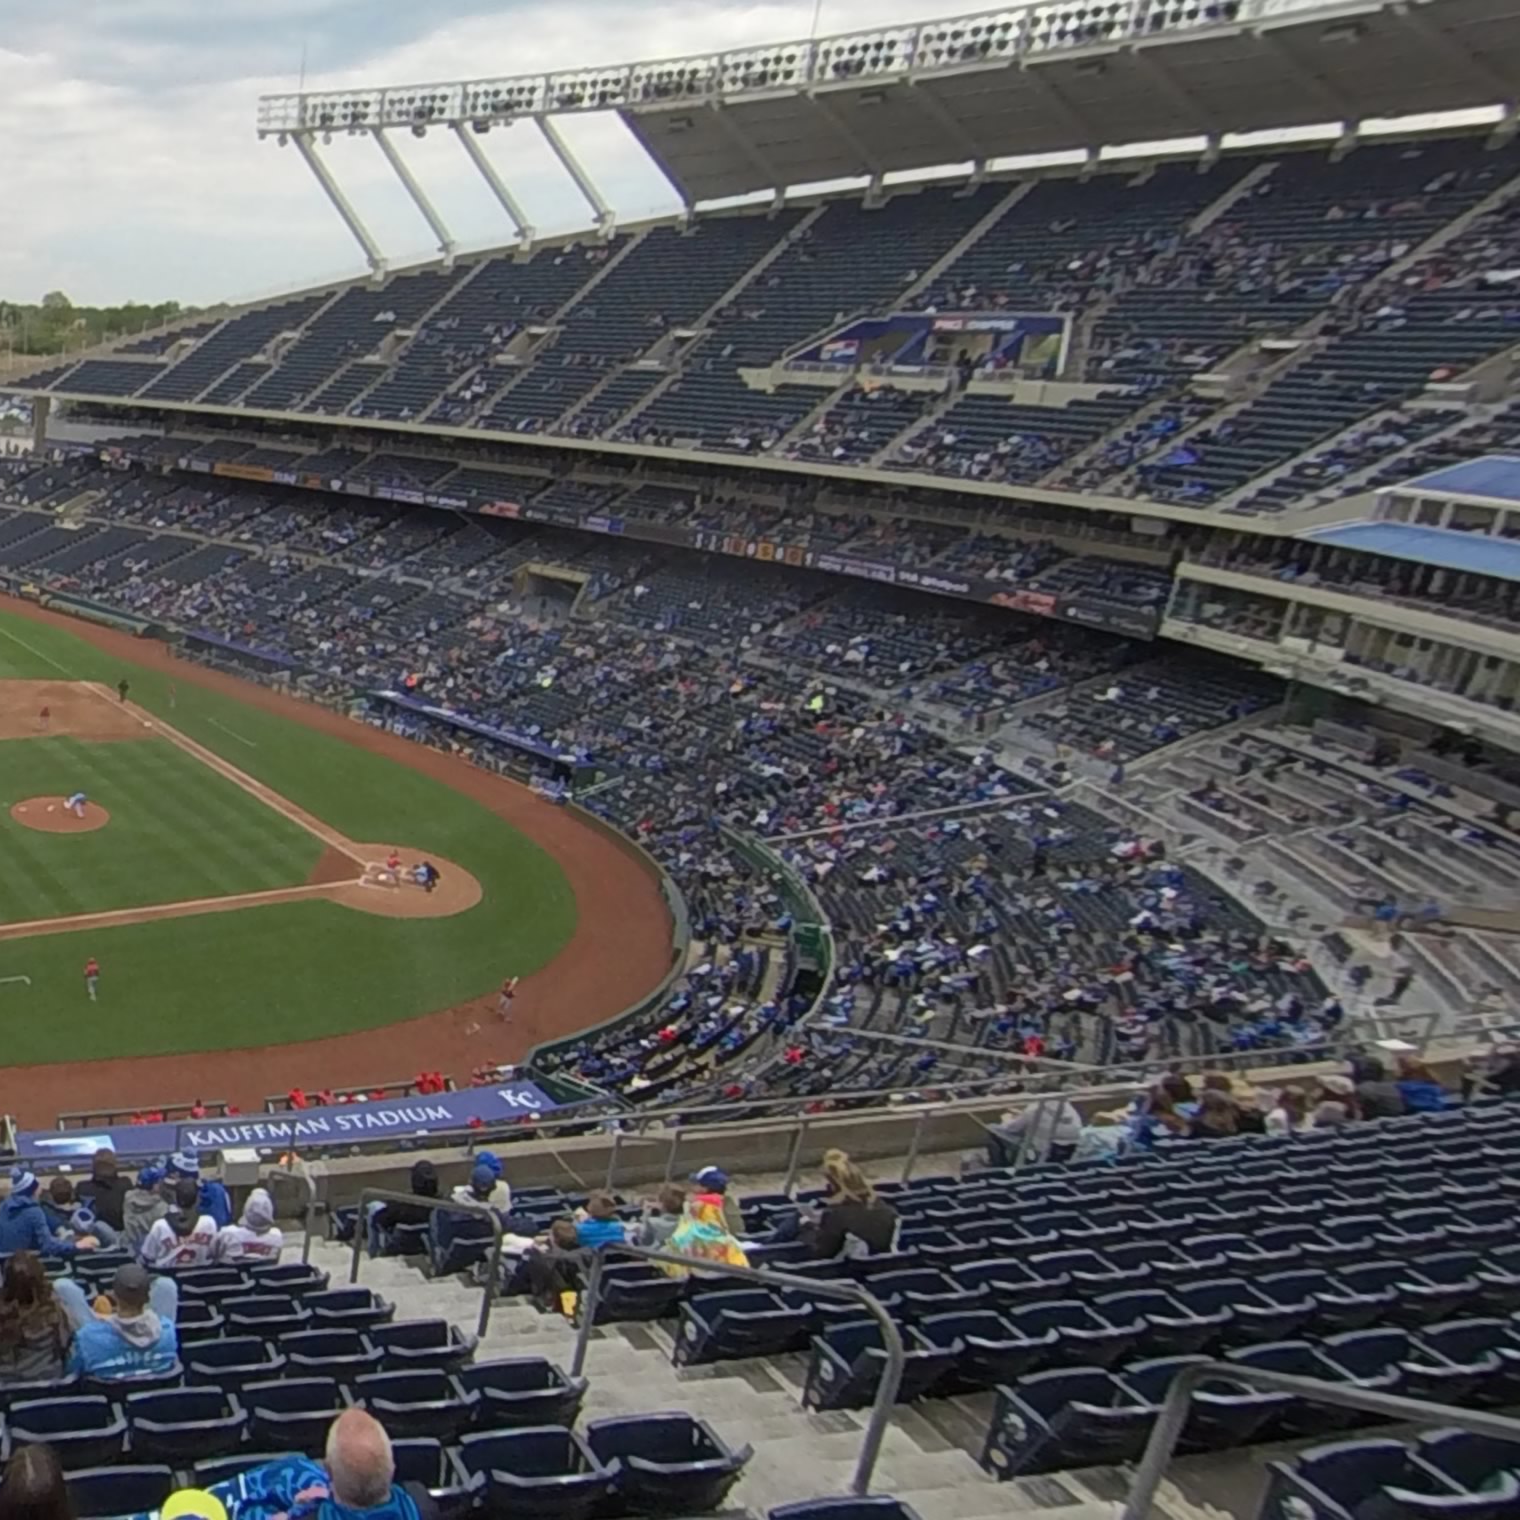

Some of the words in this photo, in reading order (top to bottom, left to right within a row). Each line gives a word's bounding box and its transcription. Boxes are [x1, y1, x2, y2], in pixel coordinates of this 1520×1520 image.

[497, 1089, 542, 1109] KC
[187, 1116, 331, 1147] KAUFFMAN
[334, 1104, 453, 1131] STADIUM
